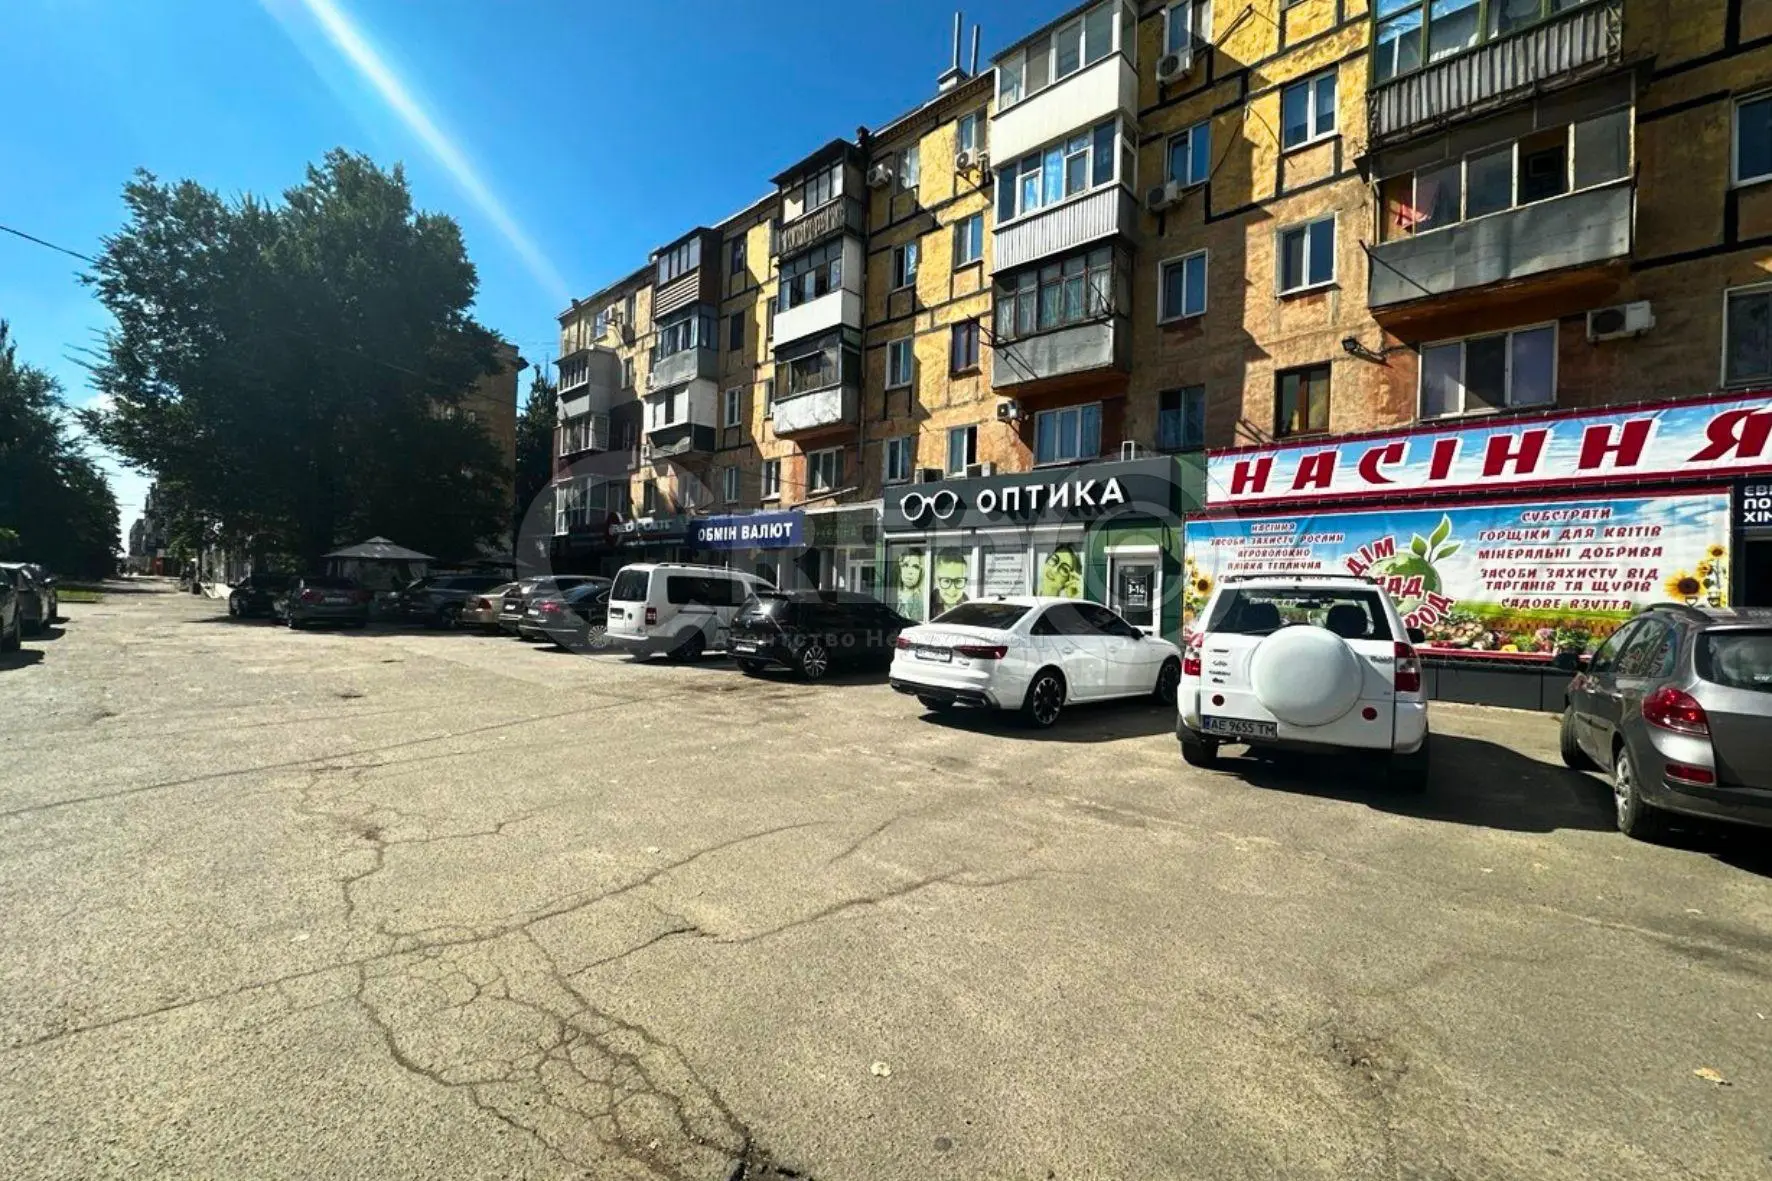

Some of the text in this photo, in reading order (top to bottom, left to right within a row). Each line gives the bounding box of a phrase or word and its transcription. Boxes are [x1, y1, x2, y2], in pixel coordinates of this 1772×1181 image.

[1230, 407, 1772, 495] НАСІННЯ
[976, 477, 1125, 513] ОПТИКА
[1521, 508, 1612, 522] СУБСТРАТИ
[698, 525, 736, 542] ОБМІН
[741, 522, 793, 540] ВАЛЮТ
[1559, 528, 1595, 540] ДЛЯ
[1604, 525, 1662, 538] КВІТІВ
[1478, 546, 1663, 560] МІНЕРАЛЬНІ ДОБРИВА
[1480, 567, 1659, 580] ЗАСОБИ ЗАХИСТУ ВІД
[1485, 580, 1651, 592] ТАРГАНІВ ТА ЩУРІВ
[1501, 598, 1632, 610] САДОВЕ ВЗУТТЯ
